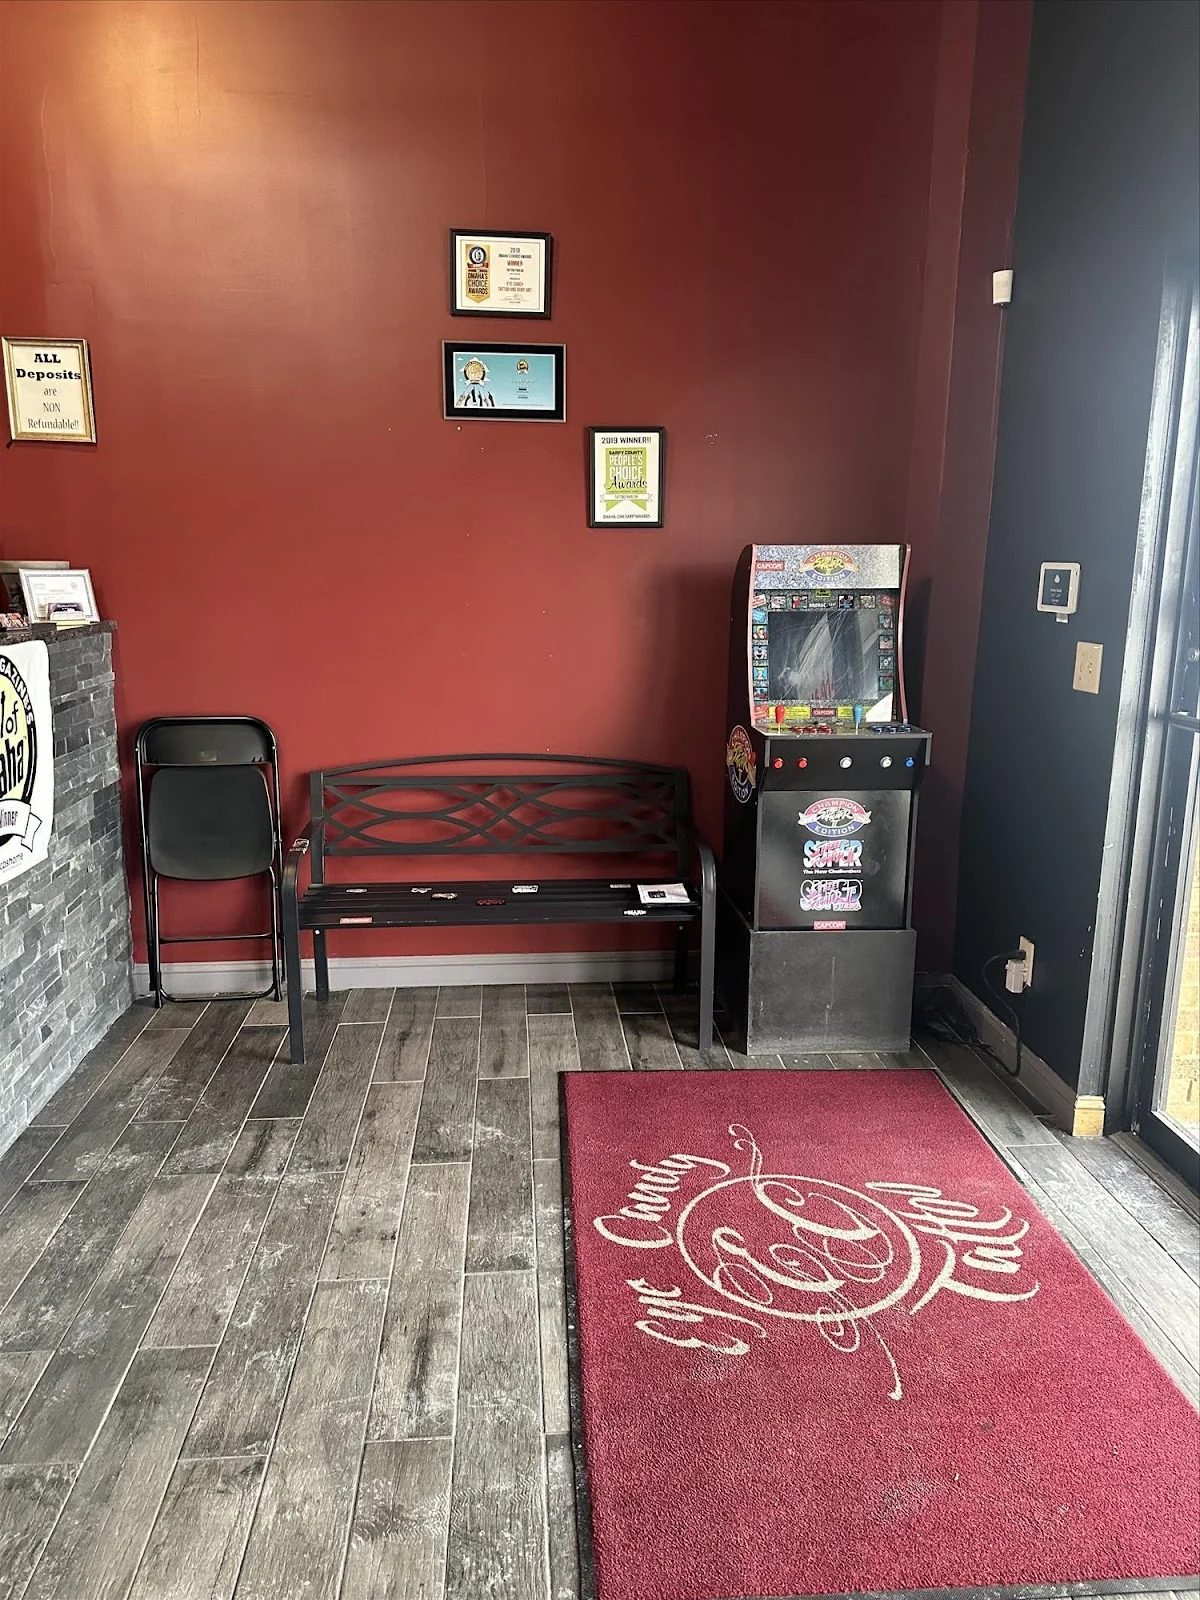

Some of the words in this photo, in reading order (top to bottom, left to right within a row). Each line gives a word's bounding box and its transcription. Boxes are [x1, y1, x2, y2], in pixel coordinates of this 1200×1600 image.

[468, 280, 488, 288] CHOICE
[34, 353, 61, 364] ALL
[16, 368, 82, 381] Deposits
[43, 387, 58, 397] are
[43, 402, 61, 413] NON
[28, 418, 79, 430] Refundable!!
[620, 436, 652, 444] WINNER!!
[609, 455, 643, 466] PEOPLE'S
[609, 466, 643, 480] CHOICE
[604, 476, 648, 490] Awards
[809, 551, 850, 562] CHAMPION
[756, 562, 783, 570] CAPCOM
[811, 572, 846, 582] EDITION
[6, 700, 19, 735] of
[811, 800, 859, 813] CHAMPION
[814, 824, 855, 835] EDITION
[592, 1153, 731, 1249] Candy
[864, 1181, 1041, 1317] Tattoo
[625, 1277, 767, 1356] Eye
